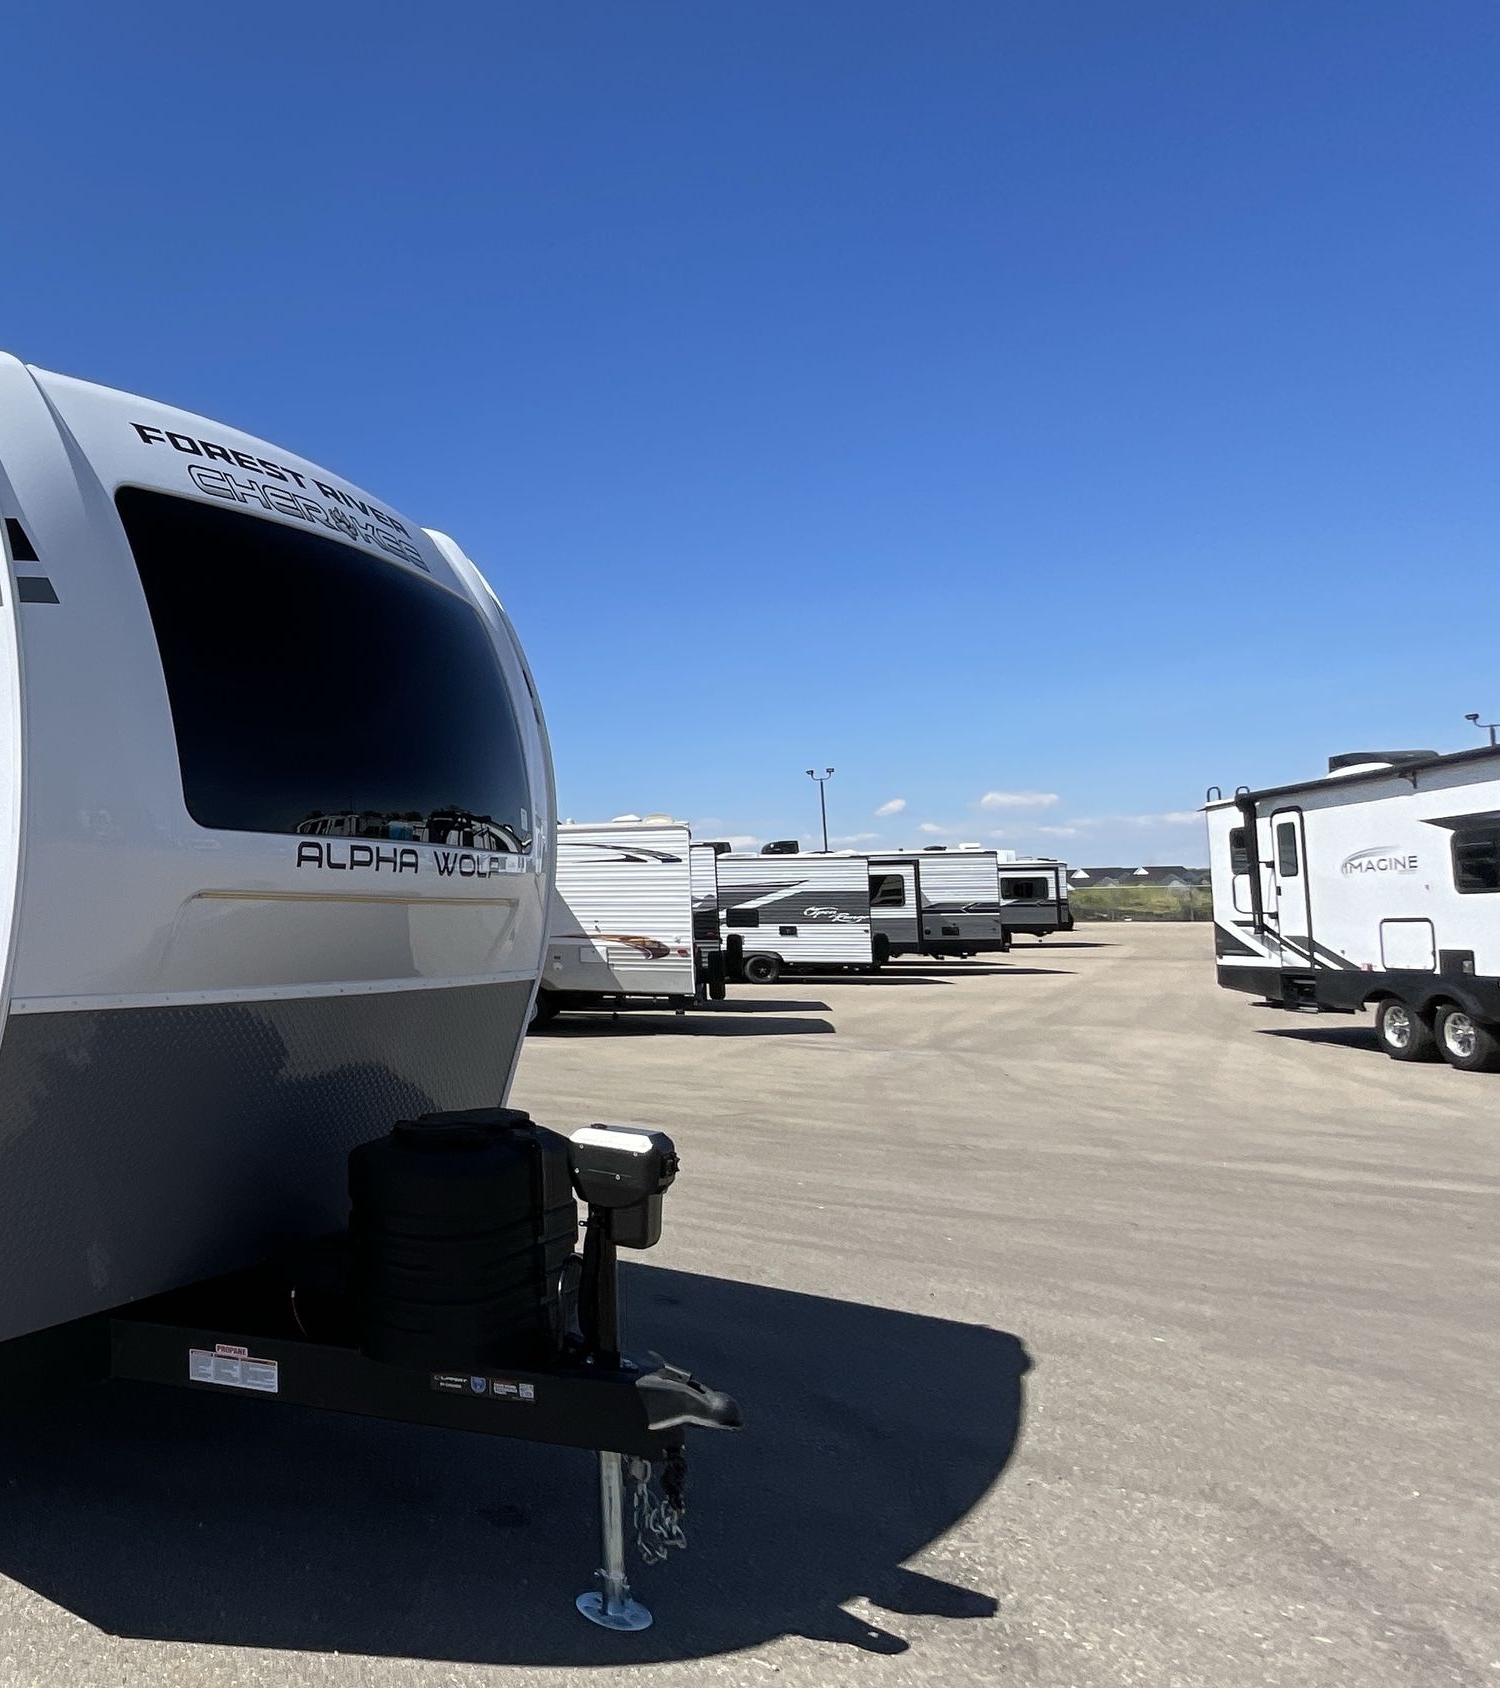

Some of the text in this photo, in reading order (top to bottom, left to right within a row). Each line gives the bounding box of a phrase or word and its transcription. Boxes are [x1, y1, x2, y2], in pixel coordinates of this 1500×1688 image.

[129, 422, 413, 540] FOREST RIVER
[296, 841, 500, 879] ALPHA WOLF
[1342, 855, 1418, 875] IMAGINE
[216, 1345, 247, 1357] PROPANE
